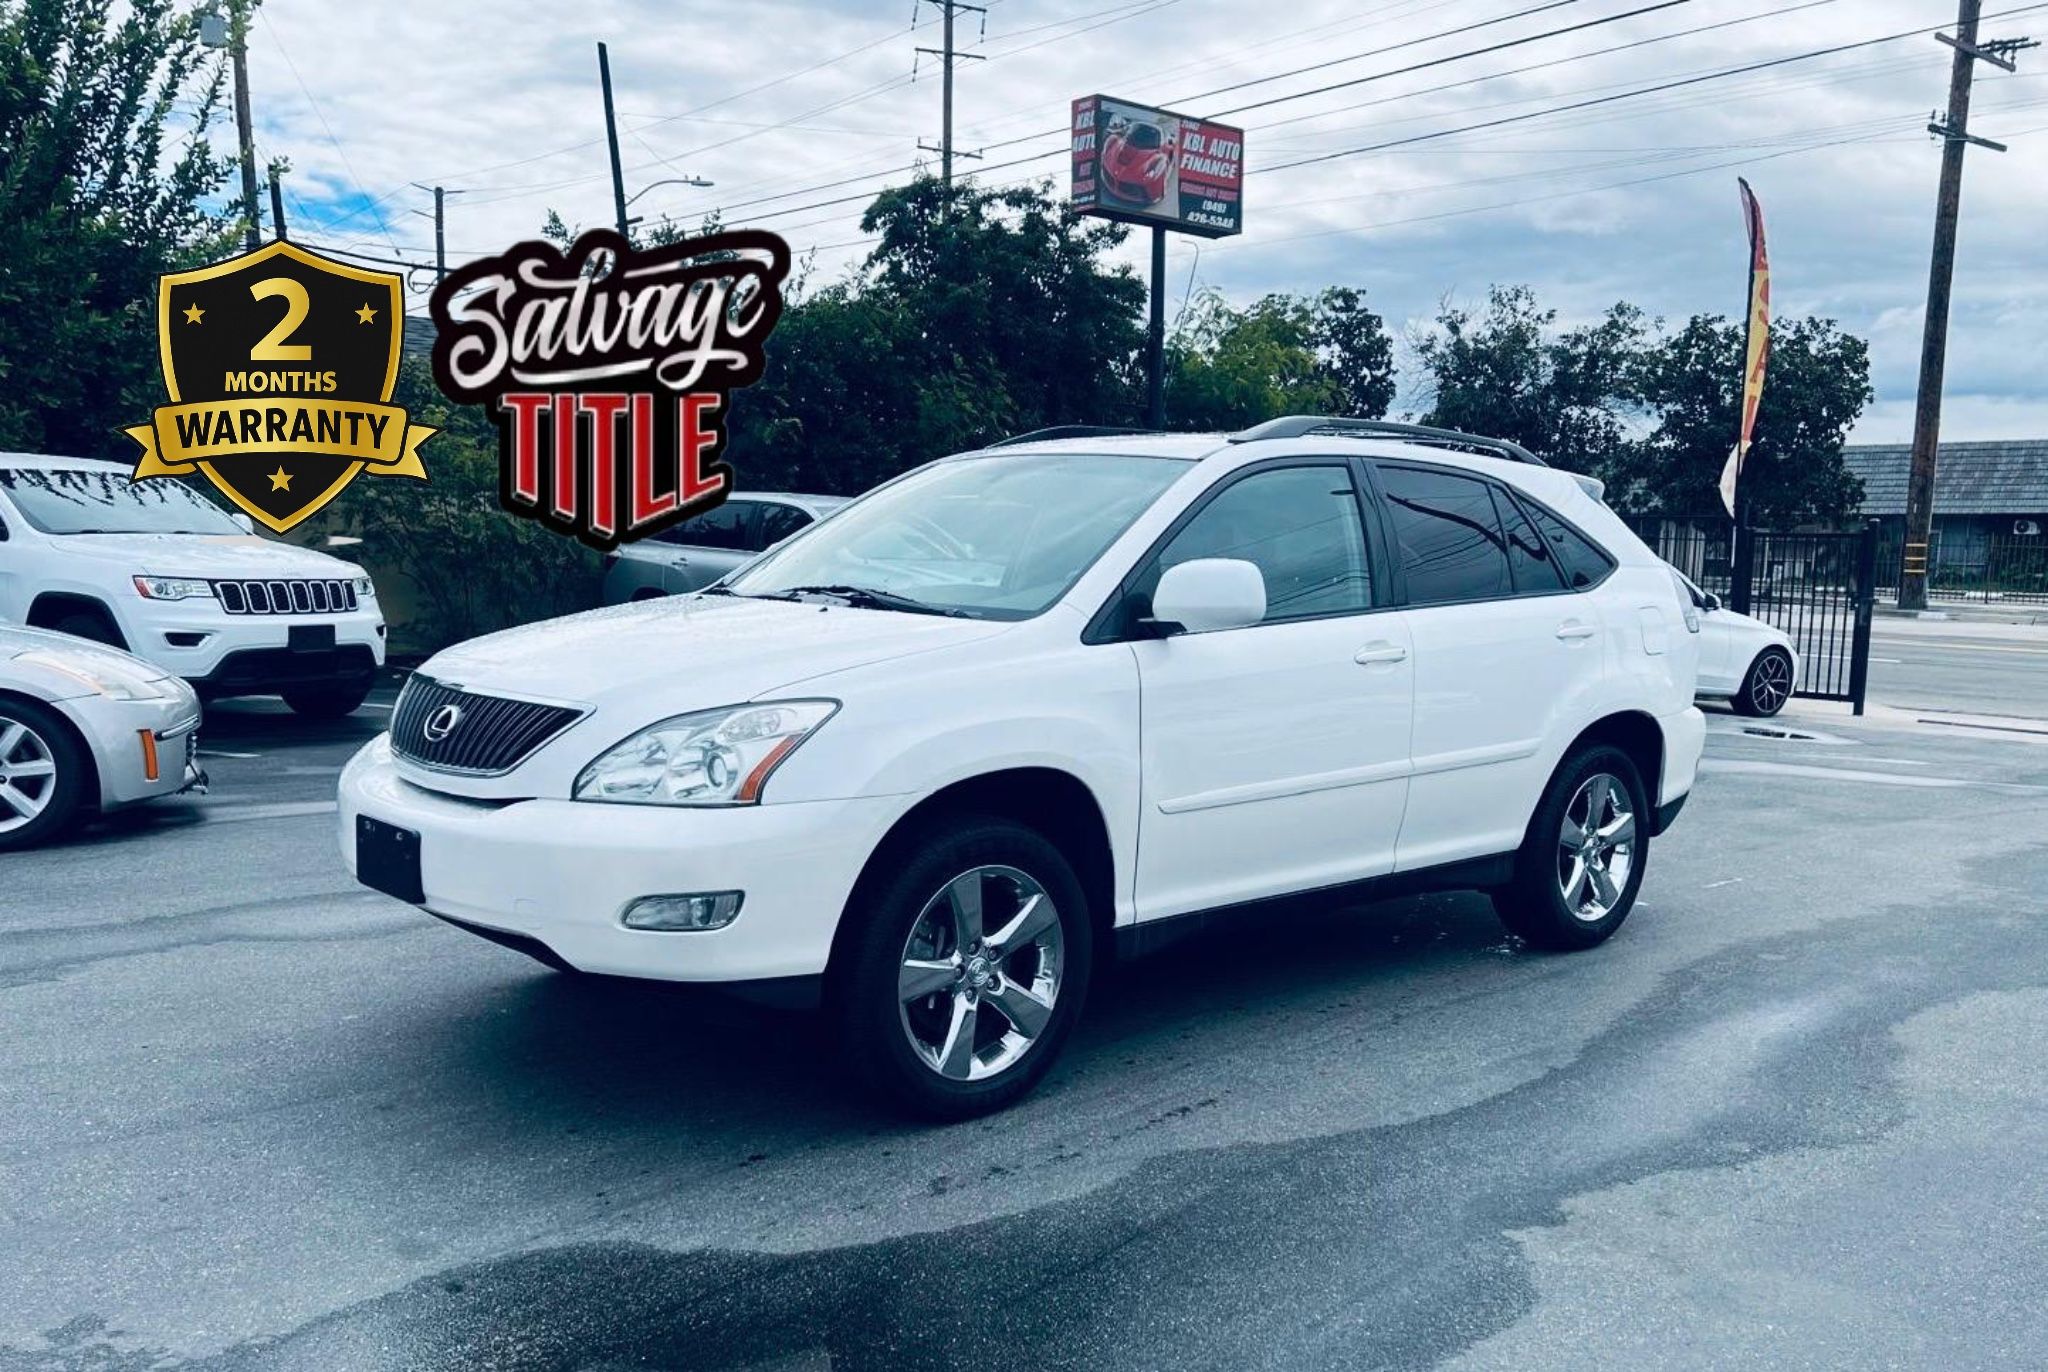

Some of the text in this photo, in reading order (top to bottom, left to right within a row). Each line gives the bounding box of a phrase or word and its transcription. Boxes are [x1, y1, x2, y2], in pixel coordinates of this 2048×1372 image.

[1183, 132, 1241, 160] KBL AUTO
[1180, 153, 1237, 178] FINANCE
